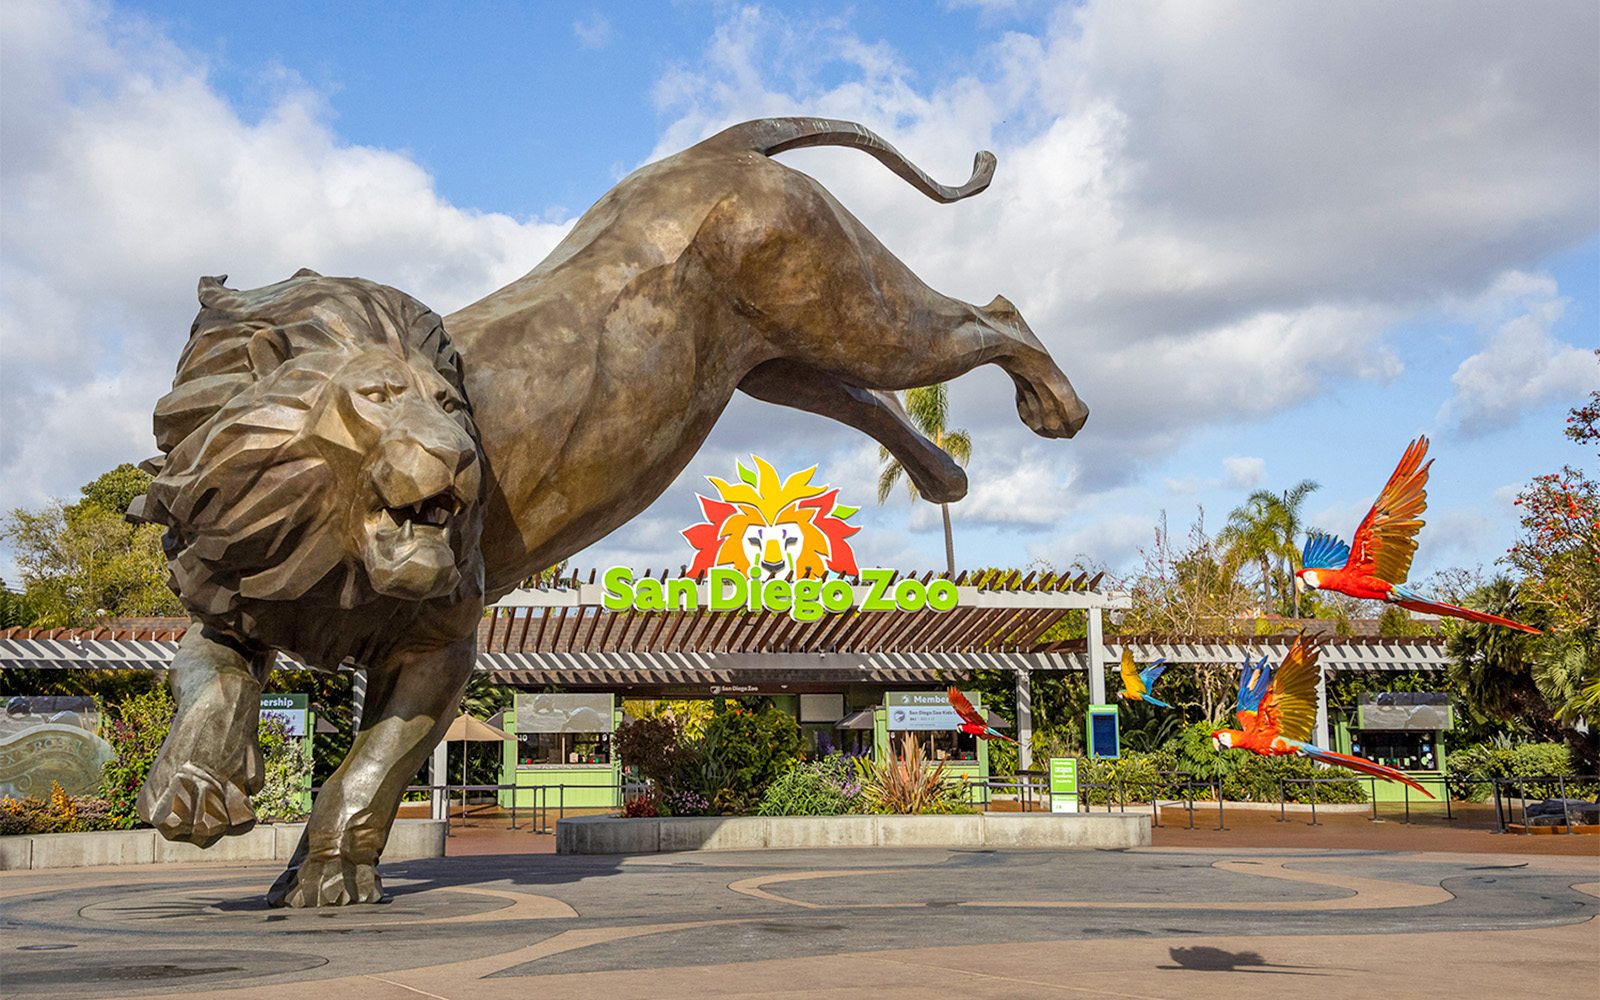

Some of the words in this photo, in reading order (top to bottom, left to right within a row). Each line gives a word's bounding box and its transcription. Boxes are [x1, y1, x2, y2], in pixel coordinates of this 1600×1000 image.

[602, 566, 698, 612] San
[709, 566, 854, 622] Diego
[861, 569, 960, 612] Zoo
[732, 685, 747, 693] Diego
